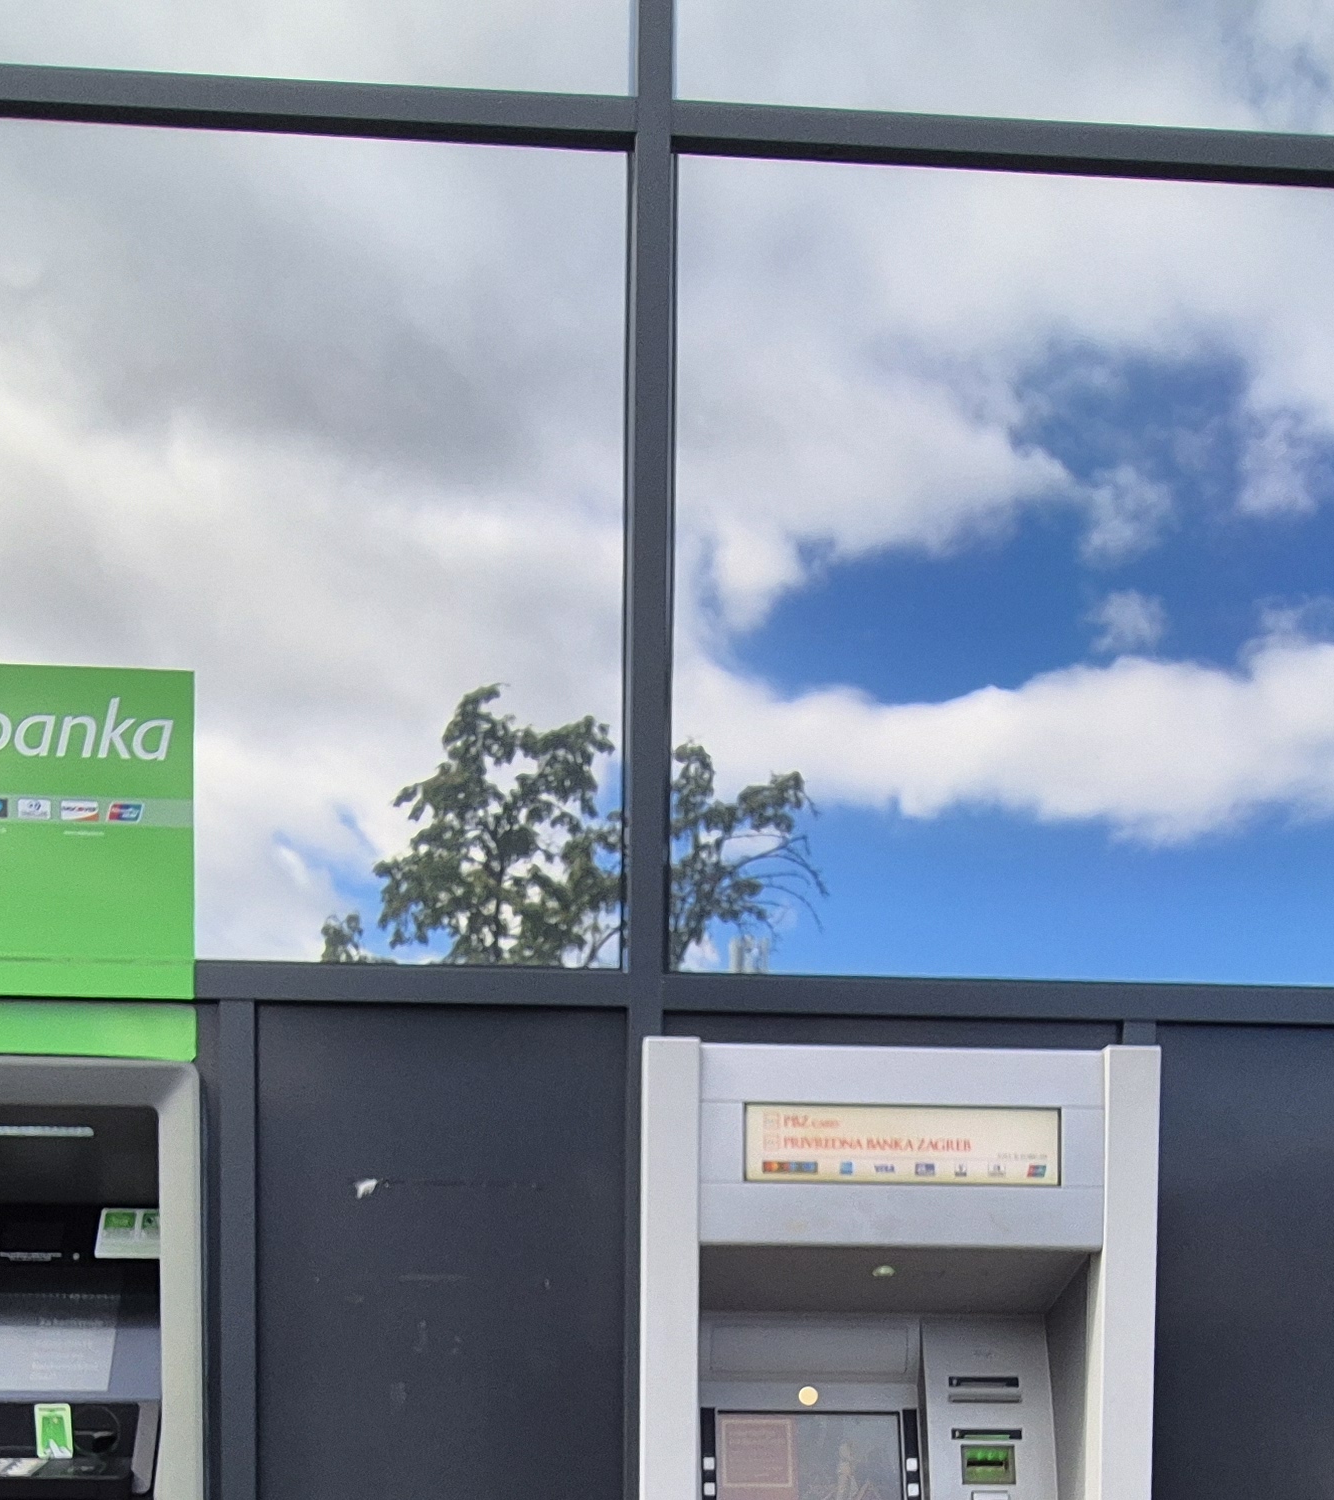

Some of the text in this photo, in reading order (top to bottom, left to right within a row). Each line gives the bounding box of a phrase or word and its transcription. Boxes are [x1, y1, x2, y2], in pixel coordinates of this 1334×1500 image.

[783, 1137, 972, 1152] PRIVREDNA BANKA ZAGREB
